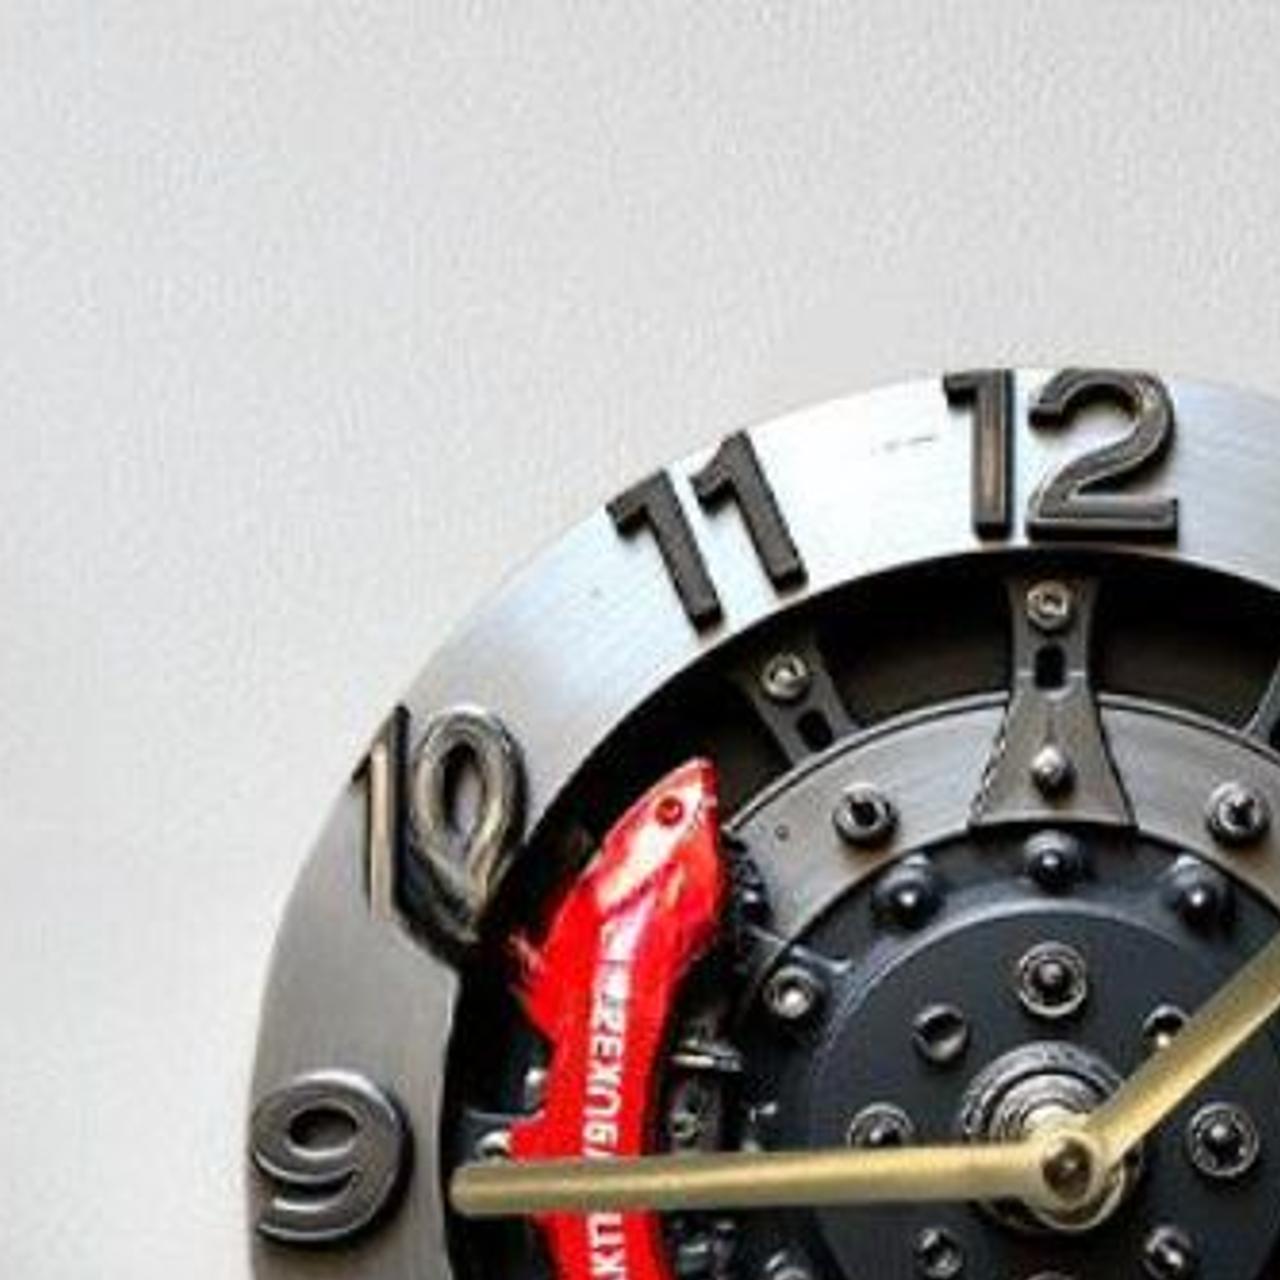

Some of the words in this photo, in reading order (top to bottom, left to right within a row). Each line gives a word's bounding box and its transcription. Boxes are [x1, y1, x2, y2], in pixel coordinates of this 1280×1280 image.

[607, 429, 806, 632] 11
[943, 369, 1178, 545] 12
[352, 705, 530, 943] 10
[252, 1068, 412, 1250] 9
